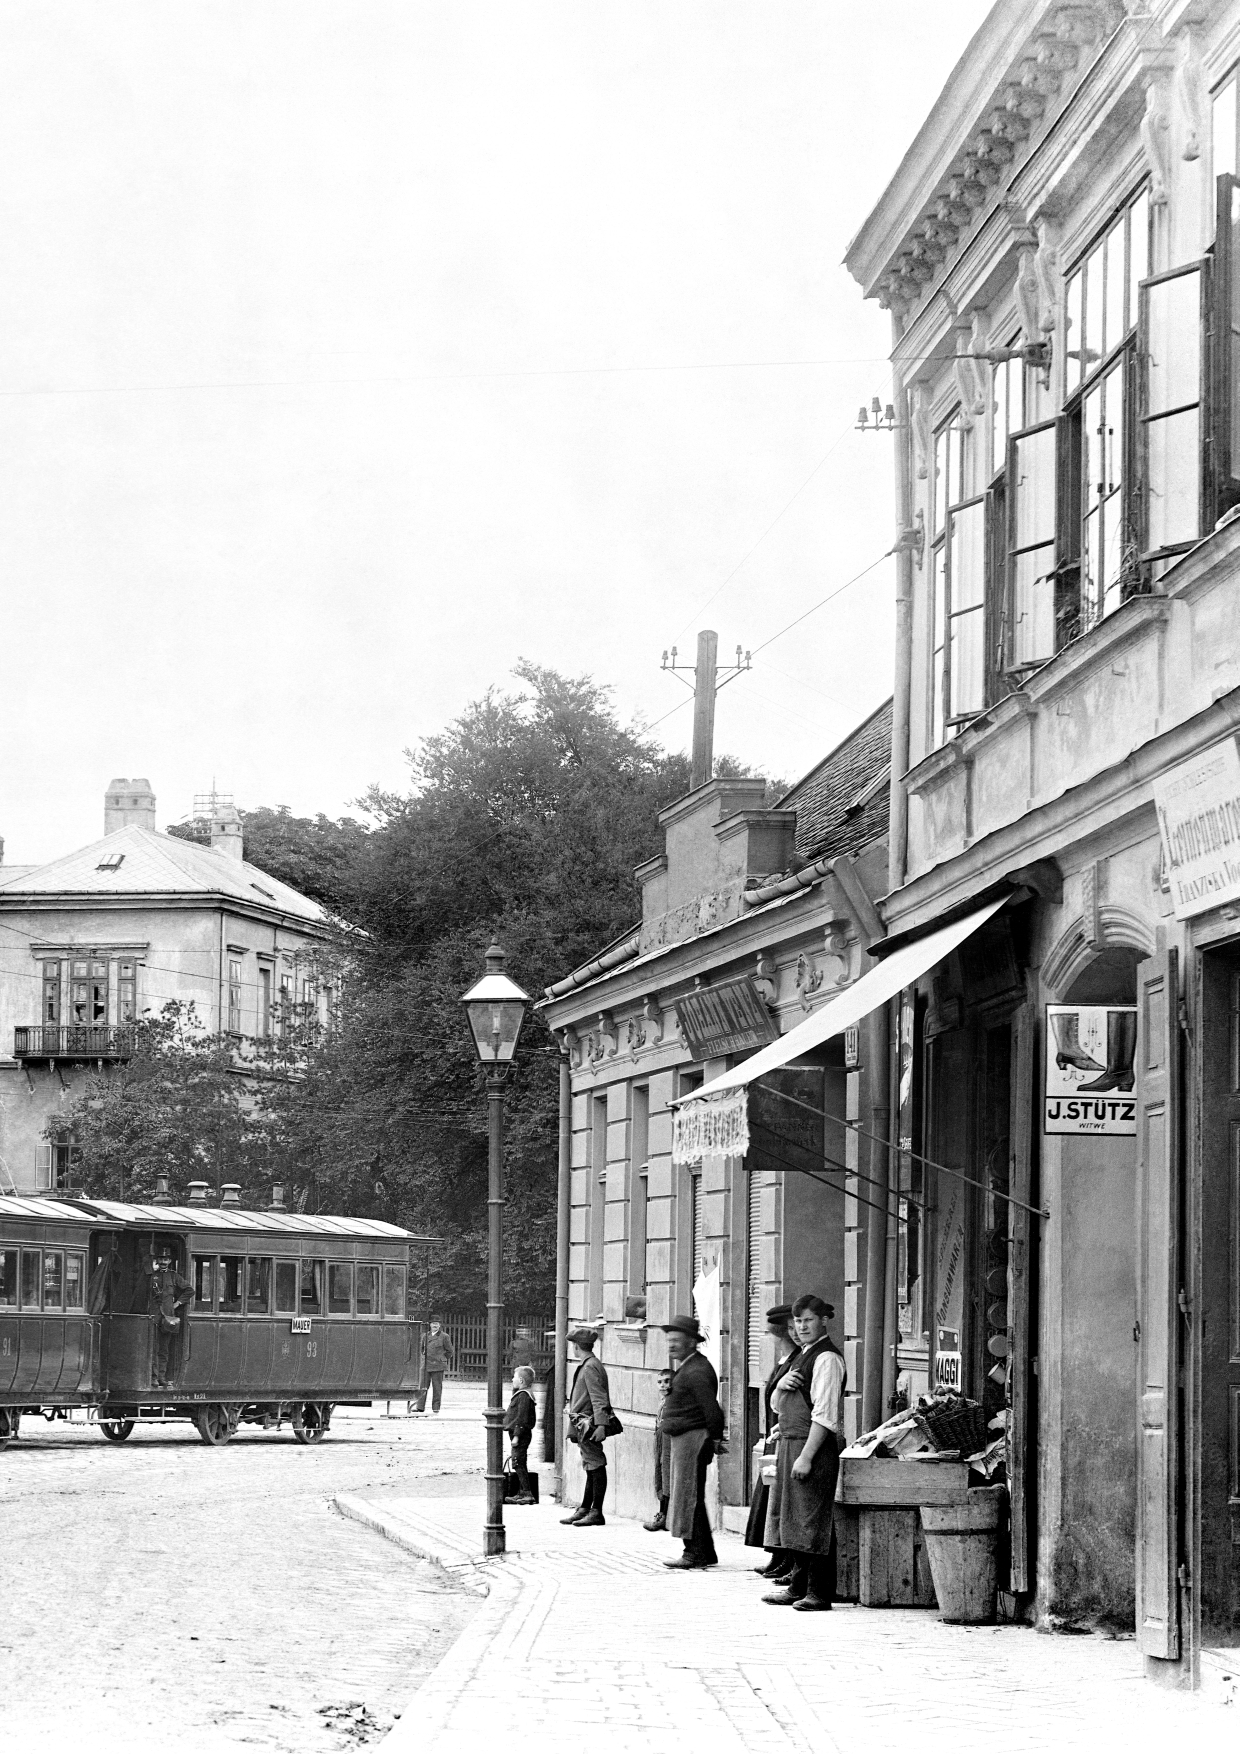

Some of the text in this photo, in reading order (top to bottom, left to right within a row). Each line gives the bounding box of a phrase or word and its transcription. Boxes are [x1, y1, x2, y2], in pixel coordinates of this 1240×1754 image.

[680, 991, 732, 1043] JOHANN
[1079, 1122, 1106, 1130] WITWE
[292, 1319, 311, 1331] MAUER
[2, 1337, 11, 1357] 91
[306, 1341, 318, 1358] 93
